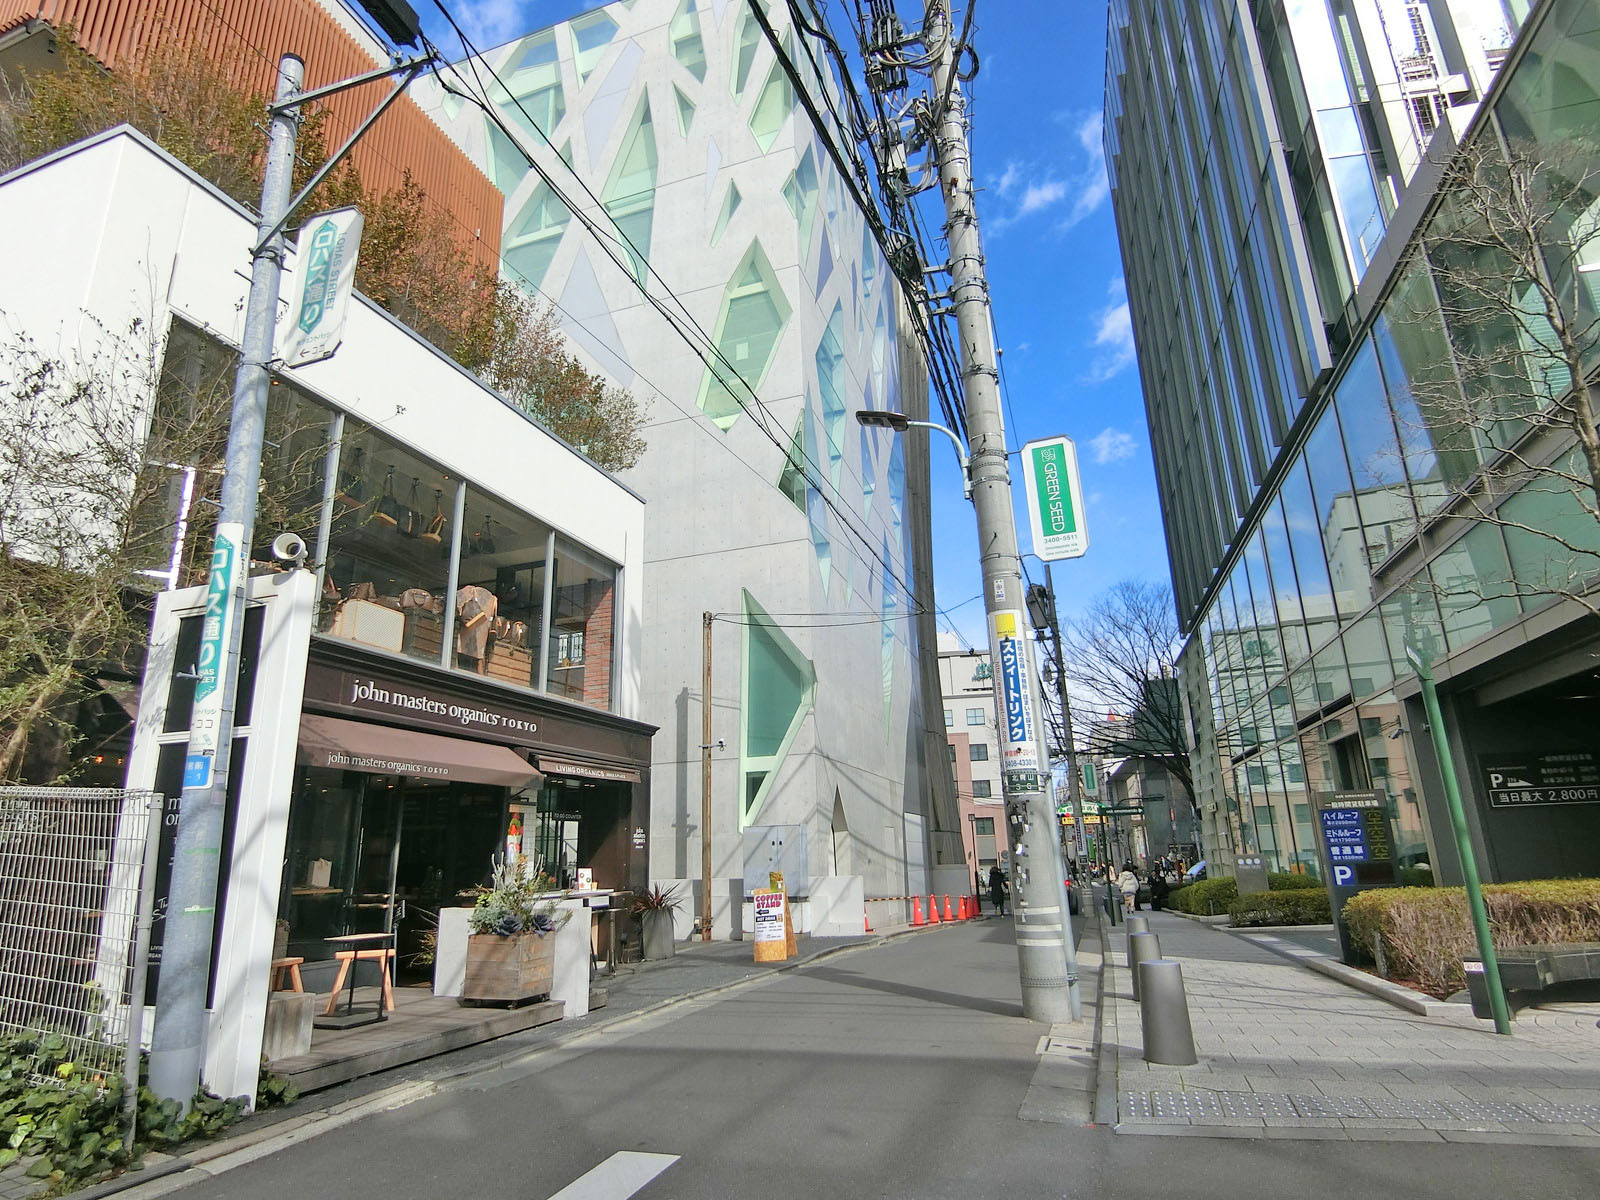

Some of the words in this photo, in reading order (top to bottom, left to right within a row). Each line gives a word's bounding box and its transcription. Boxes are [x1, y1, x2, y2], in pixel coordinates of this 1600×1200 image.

[332, 232, 346, 267] LOHAS
[304, 231, 333, 324] ロハス通り
[325, 266, 340, 311] STREET
[1044, 462, 1061, 501] GREEN
[1050, 501, 1065, 532] SEED
[1044, 534, 1078, 544] 3400-5511
[1002, 641, 1023, 740] スウィートリンク
[351, 679, 390, 703] john
[393, 692, 447, 715] masters
[449, 705, 499, 725] organics
[502, 717, 537, 732] TOKYO
[328, 752, 350, 765] john
[351, 756, 386, 768] masters
[387, 760, 421, 773] organics
[423, 766, 449, 775] TOKYO
[556, 765, 576, 774] LIVING
[577, 767, 605, 777] ORGANICS
[1490, 774, 1503, 788] P
[1499, 791, 1543, 803] 当日最大
[1323, 811, 1358, 820] ハイルーフ
[1326, 828, 1361, 838] ミドルルーフ
[1330, 845, 1364, 855] 普通車
[1333, 865, 1352, 885] P
[755, 894, 782, 902] COFFEE
[757, 901, 781, 909] STAND
